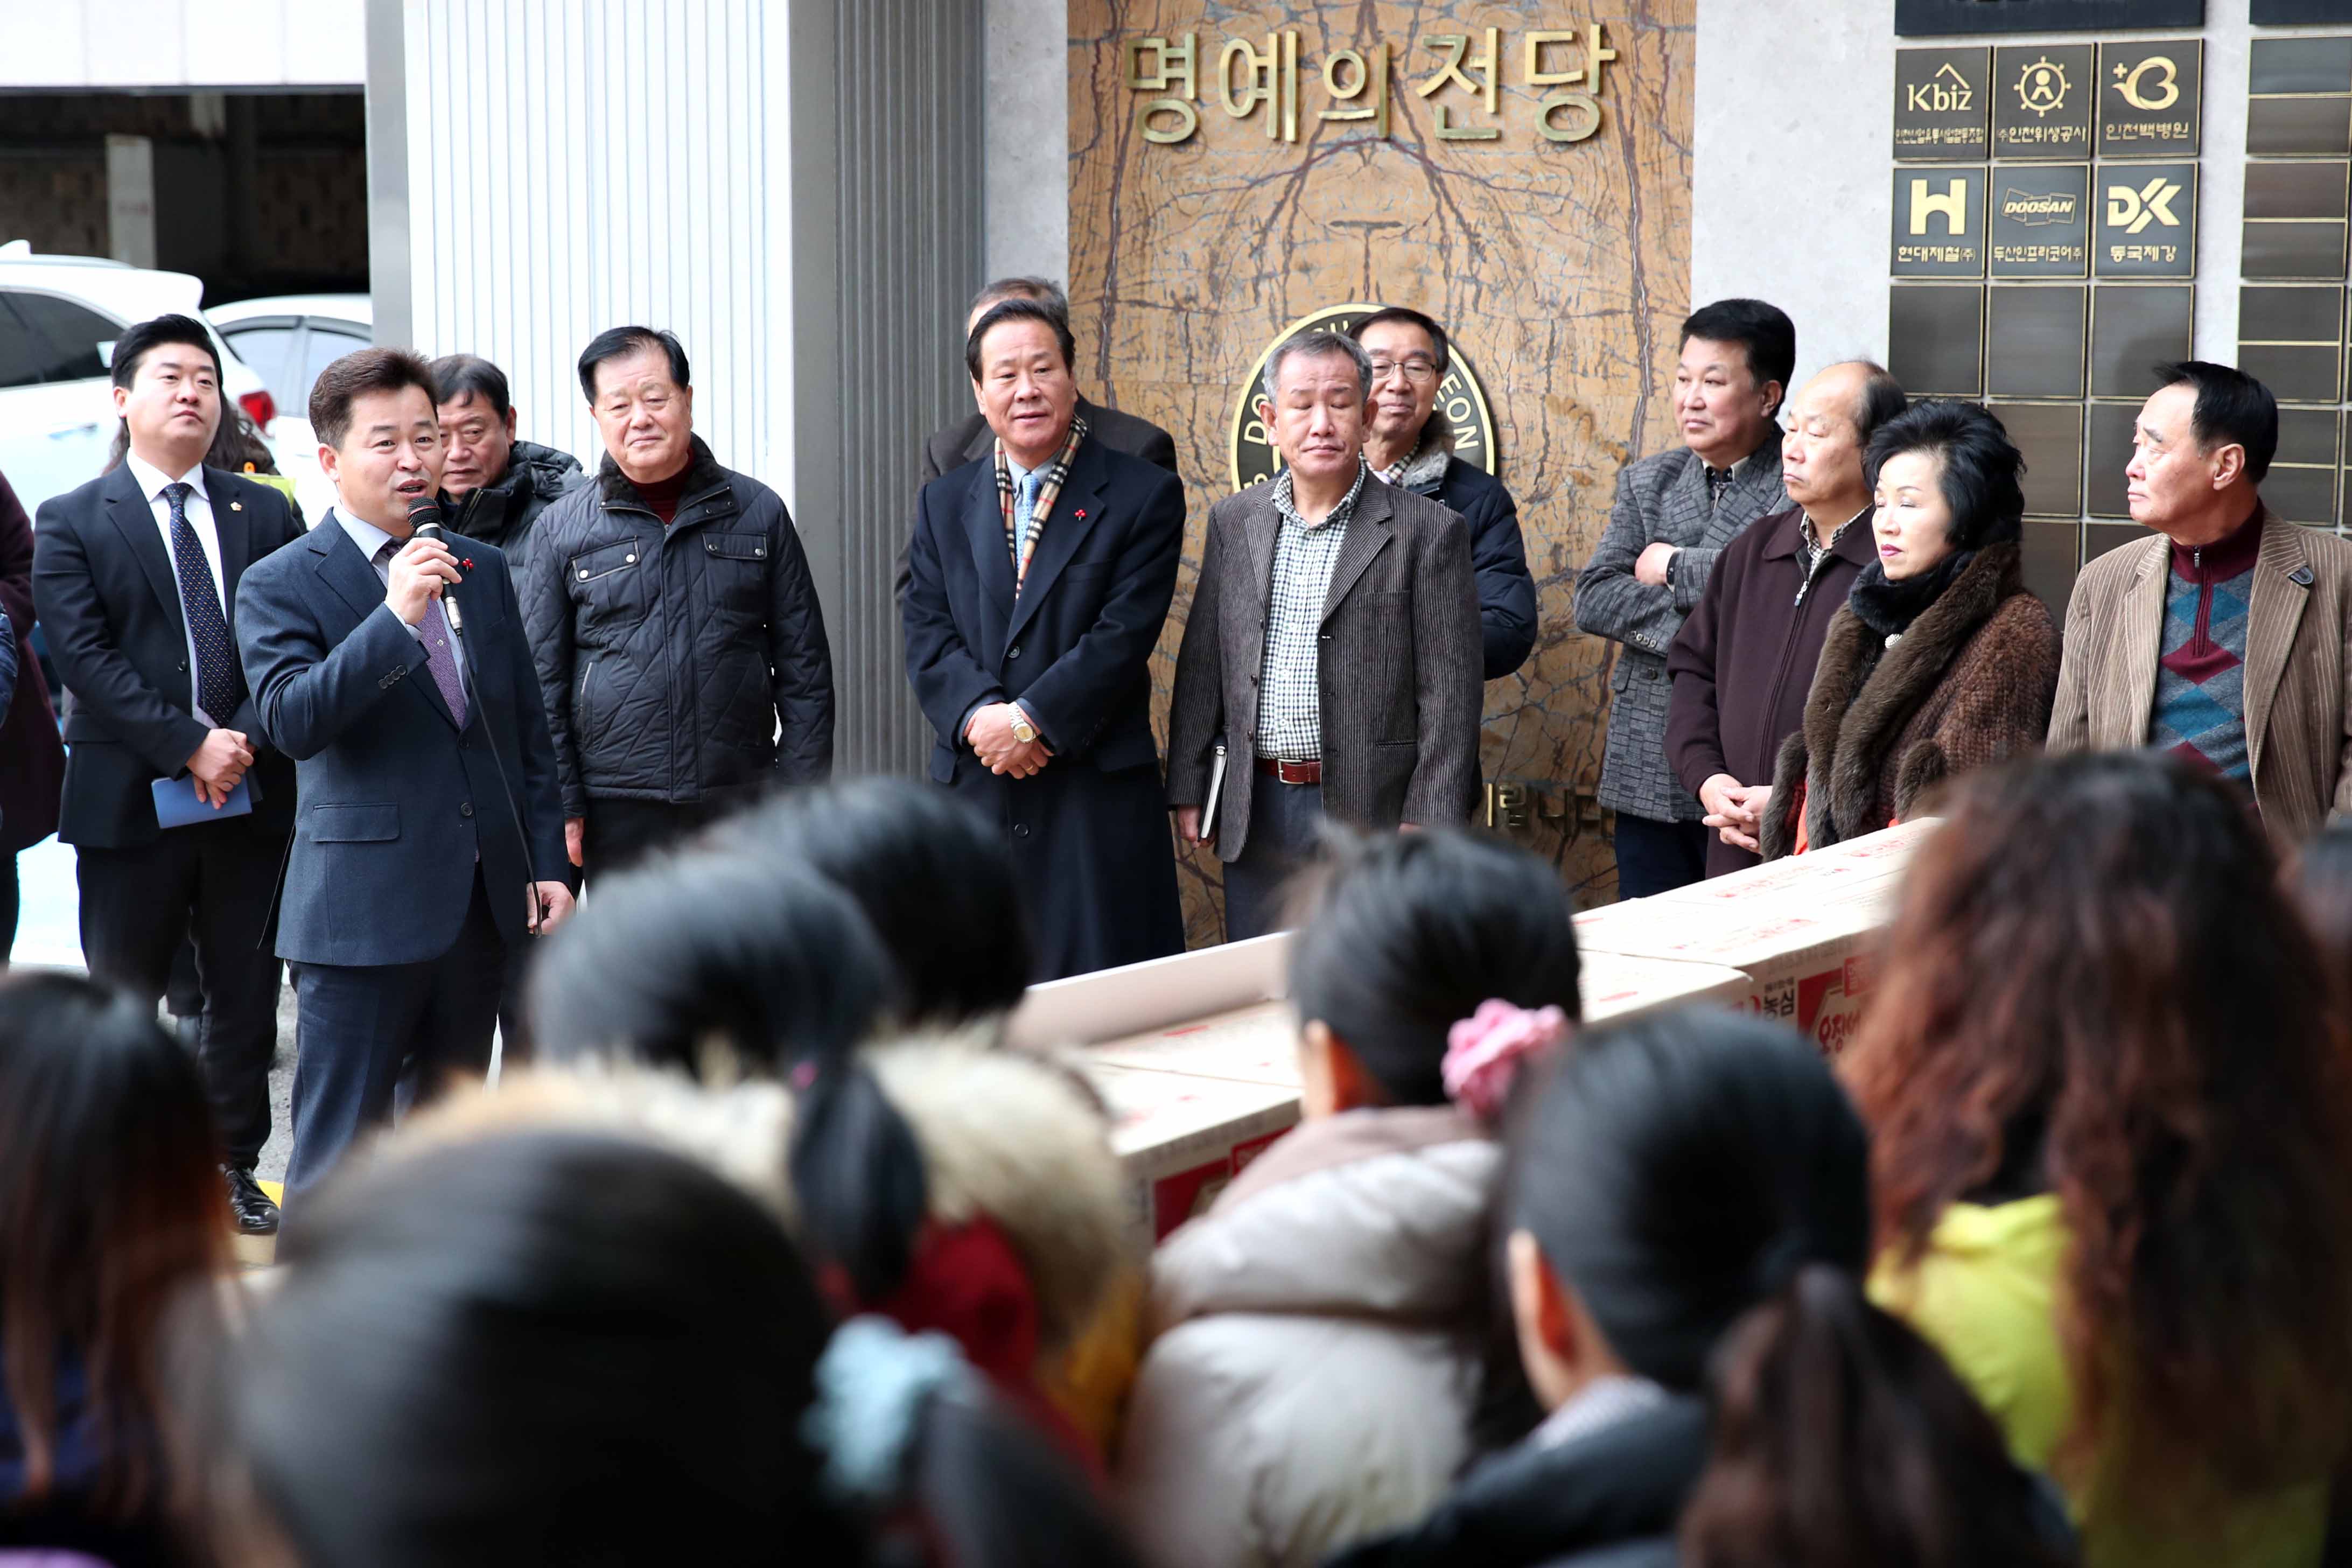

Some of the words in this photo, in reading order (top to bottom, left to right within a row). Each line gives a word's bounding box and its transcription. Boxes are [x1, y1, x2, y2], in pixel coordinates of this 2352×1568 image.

[1906, 83, 1973, 112] Kbiz
[2106, 122, 2189, 141] 인천백병원
[2004, 200, 2074, 214] DOOSAN
[2110, 245, 2177, 263] 동국제강
